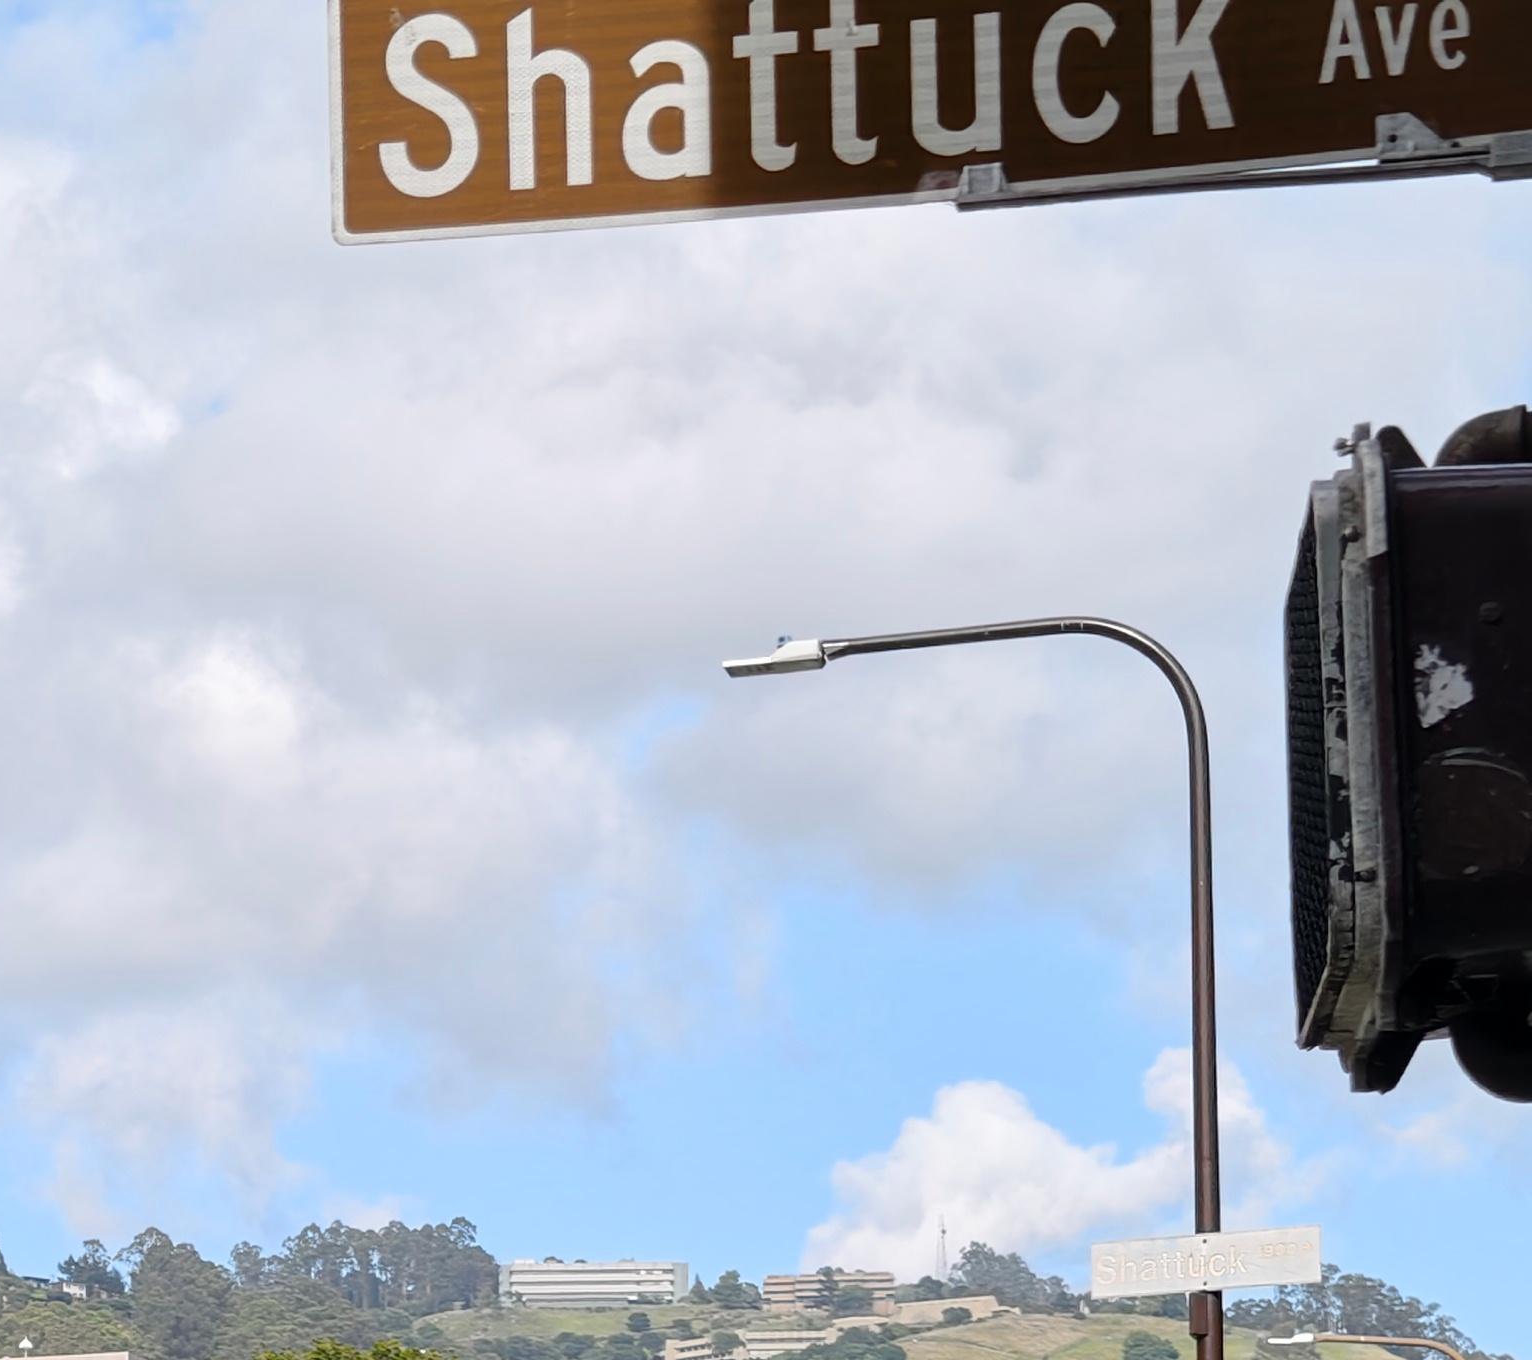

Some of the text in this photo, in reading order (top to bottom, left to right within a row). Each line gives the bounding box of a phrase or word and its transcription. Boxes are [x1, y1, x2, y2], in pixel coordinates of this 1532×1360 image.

[378, 0, 1469, 198] Shattuck Ave
[1096, 1244, 1248, 1285] Shattuck
